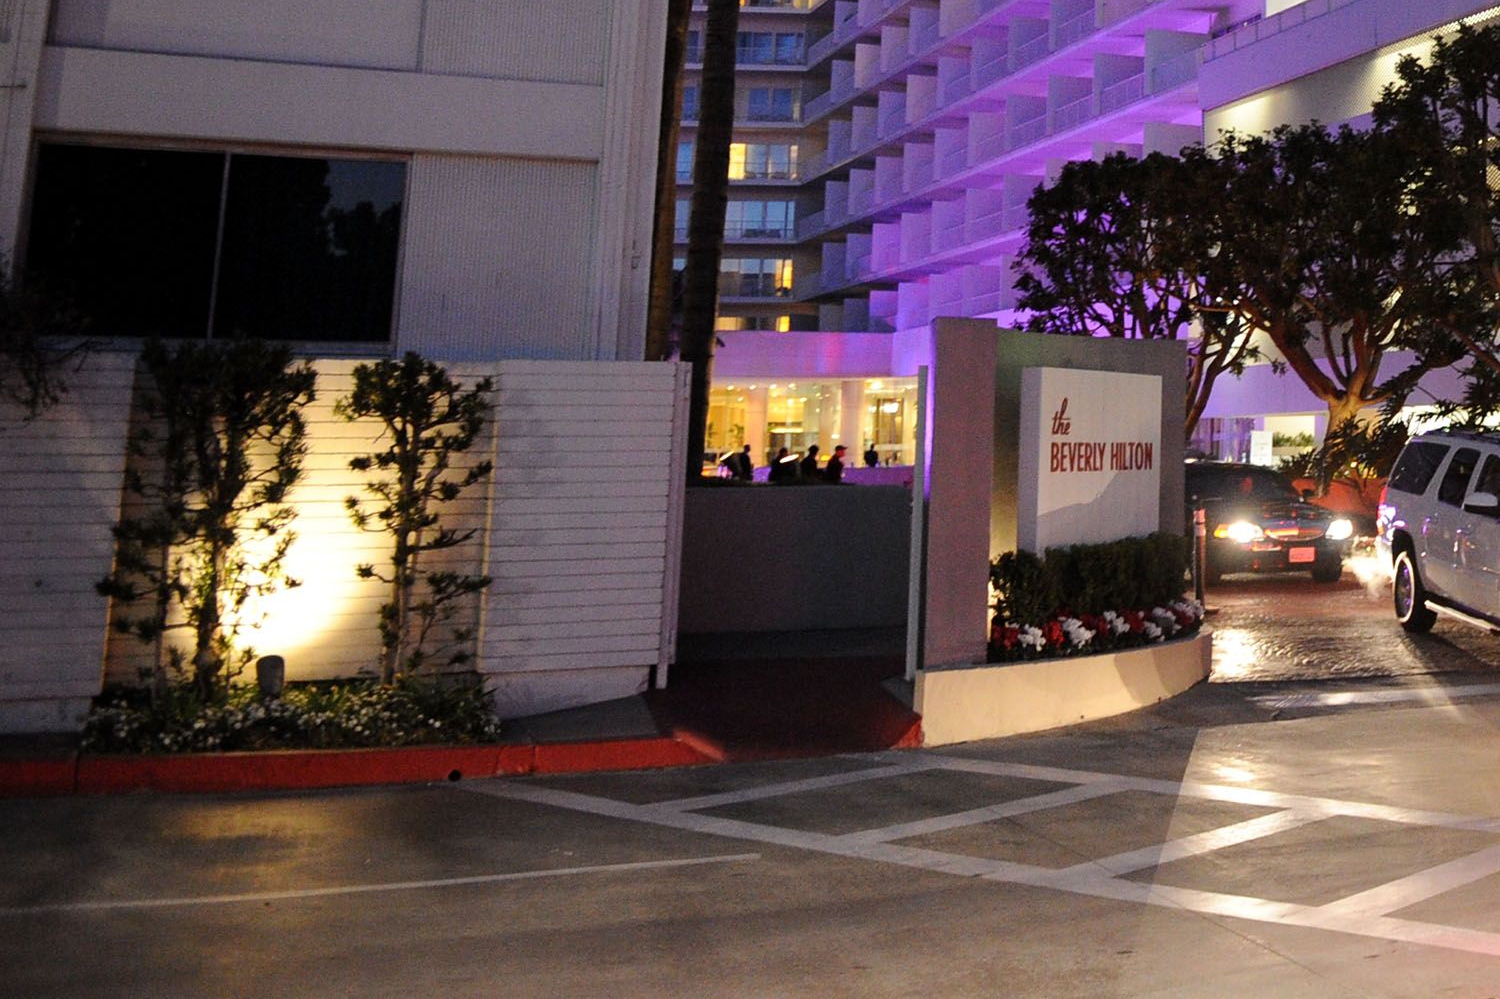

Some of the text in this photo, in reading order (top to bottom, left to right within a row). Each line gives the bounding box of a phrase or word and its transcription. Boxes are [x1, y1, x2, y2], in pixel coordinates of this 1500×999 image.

[1051, 397, 1071, 435] the
[1050, 442, 1153, 473] BEVERLY HILTON
